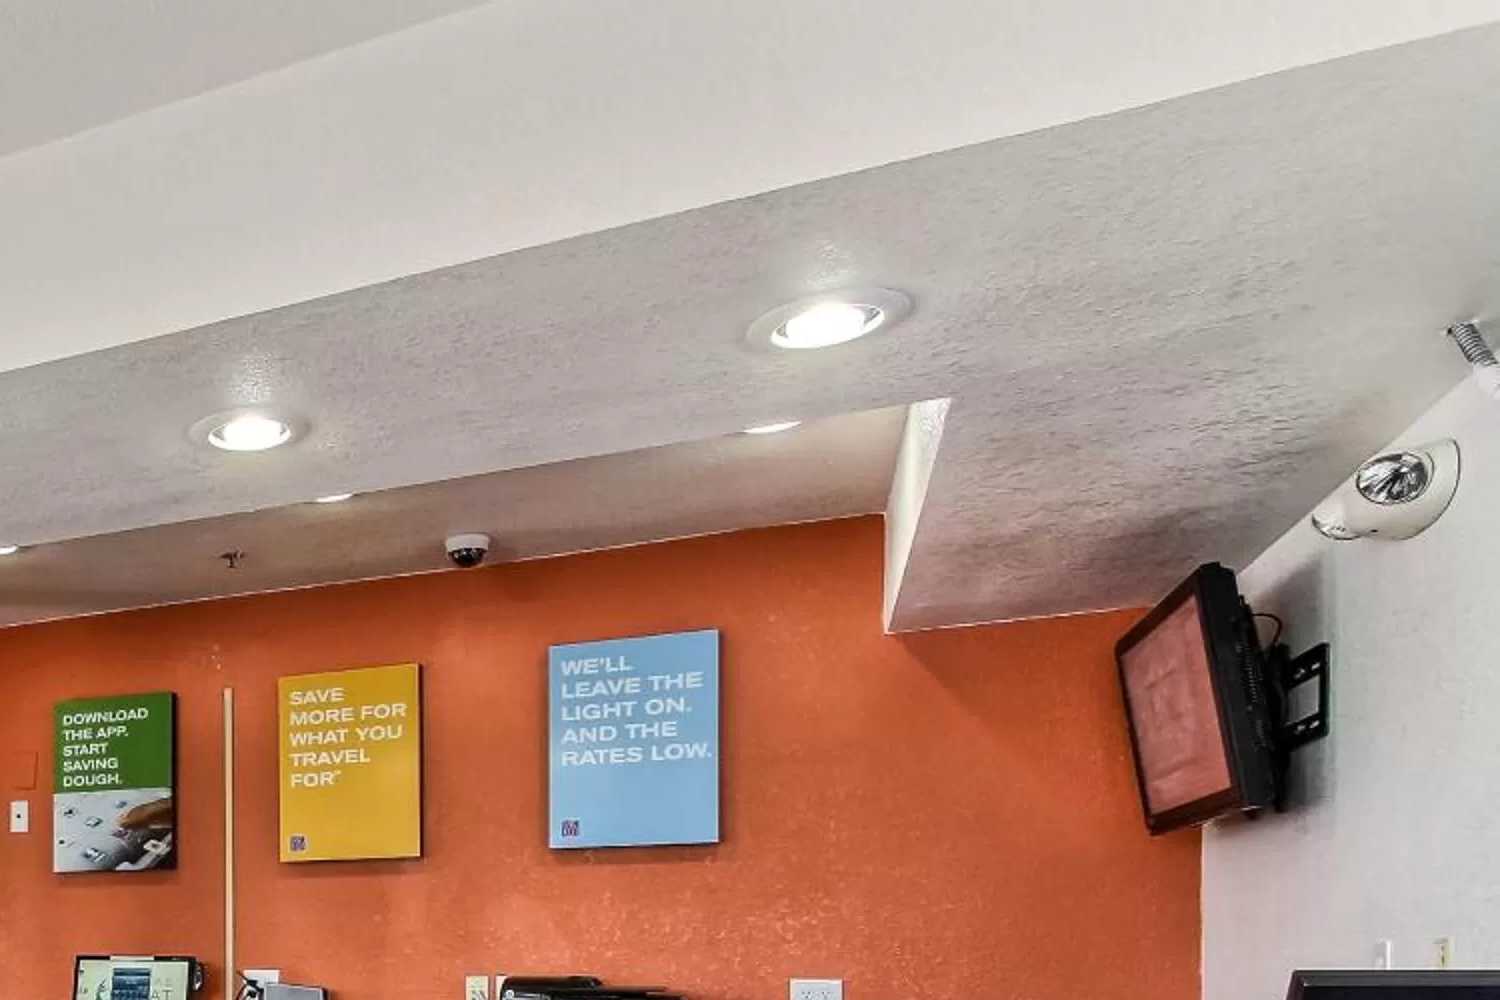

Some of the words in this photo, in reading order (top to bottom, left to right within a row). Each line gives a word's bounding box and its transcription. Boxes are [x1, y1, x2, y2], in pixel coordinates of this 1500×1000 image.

[560, 655, 633, 676] WE'LL
[561, 677, 641, 698] LEAVE
[648, 671, 704, 691] THE
[289, 687, 345, 706] SAVE
[63, 707, 149, 726] DOWNLOAD
[289, 707, 354, 726] MORE
[360, 703, 407, 720] FOR
[561, 701, 637, 721] LIGHT
[644, 697, 693, 716] ON.
[63, 728, 93, 742] THE
[95, 725, 129, 740] APP.
[289, 728, 349, 747] WHAT
[355, 724, 403, 742] YOU
[561, 725, 618, 745] AND
[624, 721, 678, 740] THE
[63, 743, 108, 757] START
[290, 748, 371, 767] TRAVEL
[561, 747, 643, 767] RATES
[651, 742, 713, 761] LOW.
[63, 757, 119, 773] SAVING
[63, 773, 122, 788] DOUGH.
